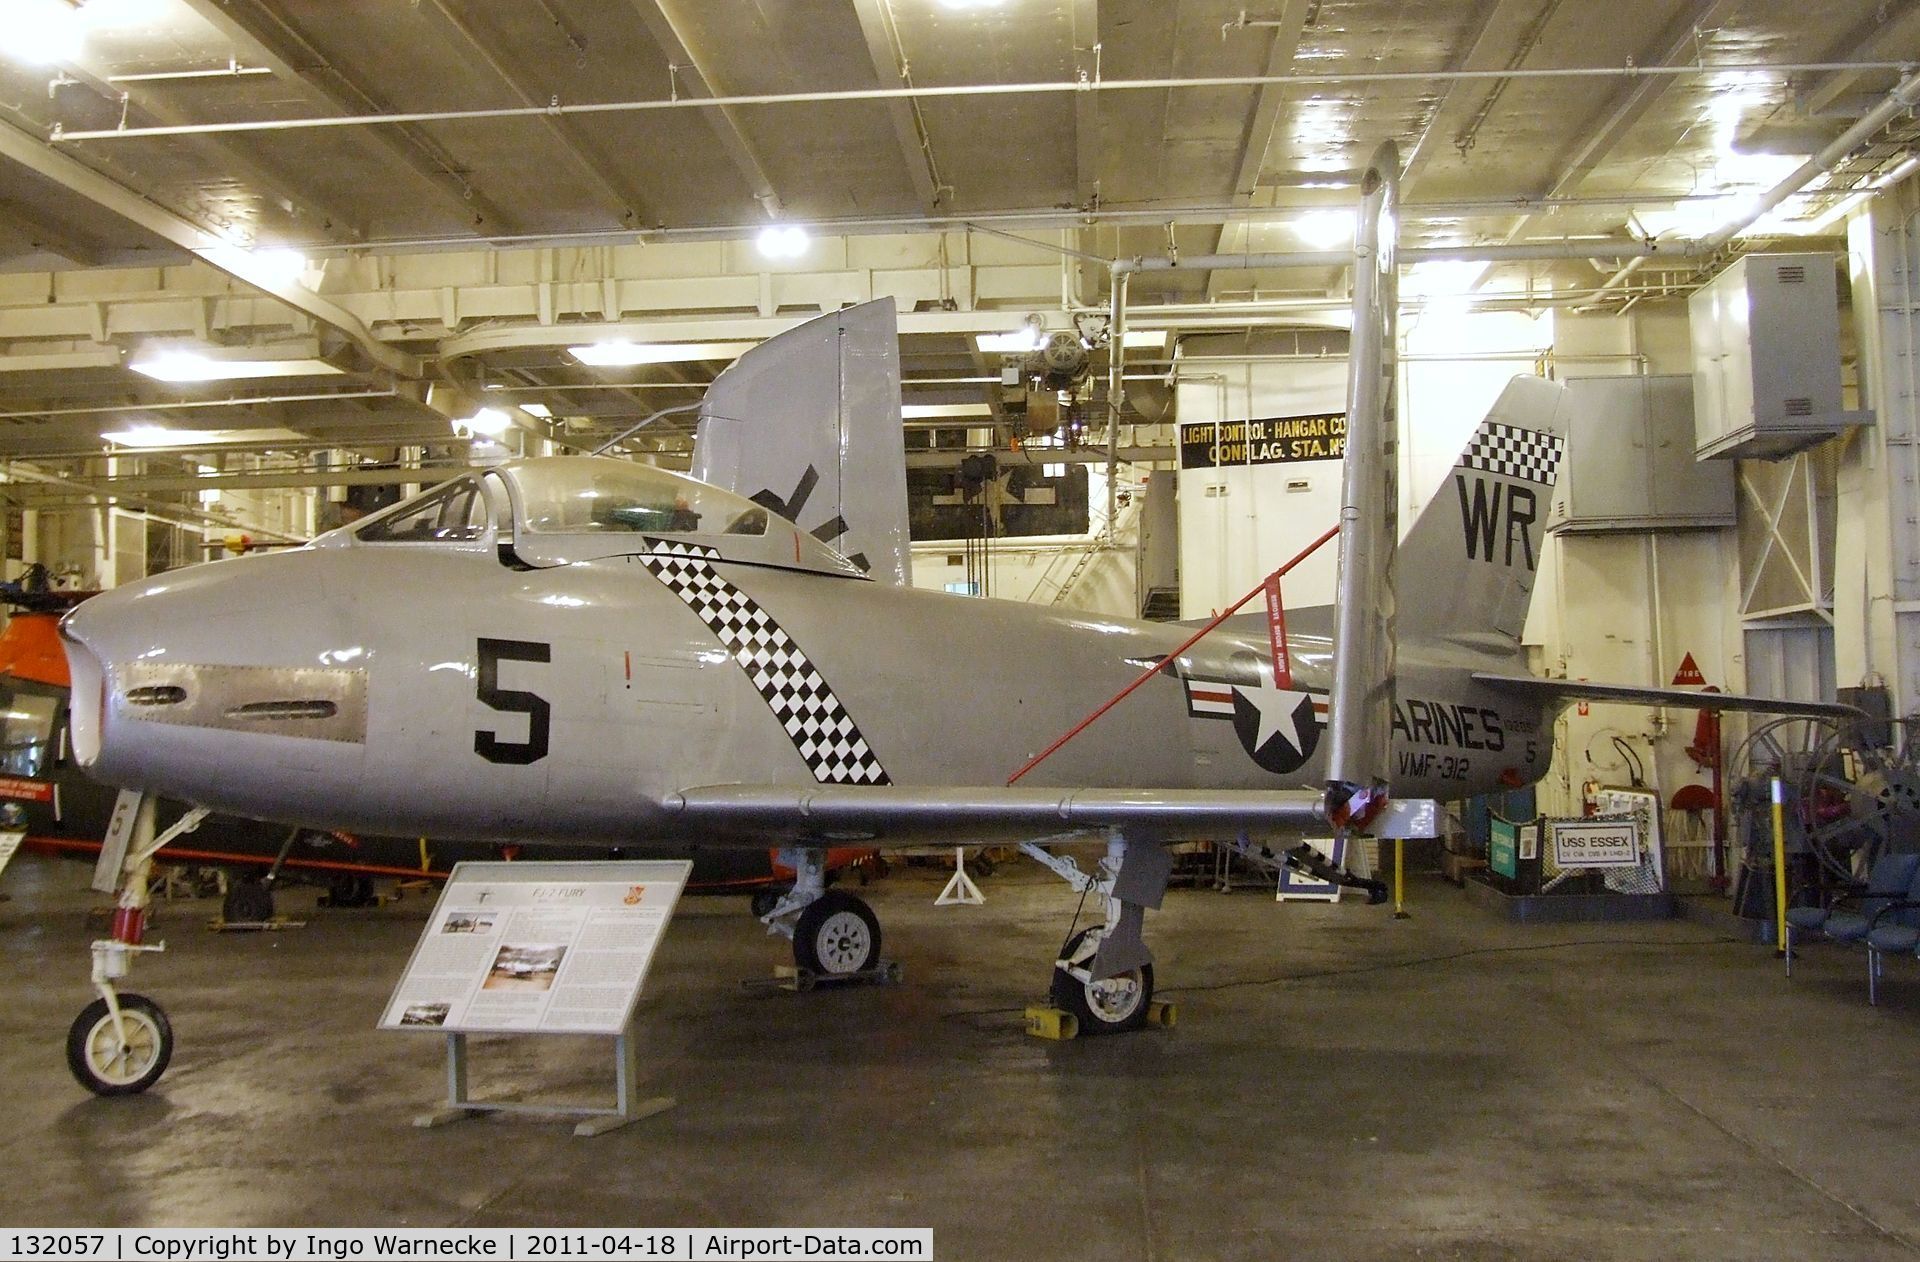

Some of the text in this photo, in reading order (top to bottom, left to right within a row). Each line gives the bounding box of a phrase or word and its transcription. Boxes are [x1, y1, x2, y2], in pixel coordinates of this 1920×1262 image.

[1183, 425, 1215, 445] LIGHT
[1275, 418, 1327, 439] HANGAR
[1330, 417, 1346, 435] CO
[1291, 439, 1327, 459] STA.
[1455, 474, 1535, 572] WR
[1677, 670, 1700, 678] FIRE
[474, 637, 551, 765] 5
[1390, 699, 1504, 752] ARINES
[1398, 751, 1470, 781] VMF-312
[1562, 836, 1629, 848] USS ESSEX
[559, 888, 586, 897] FURY
